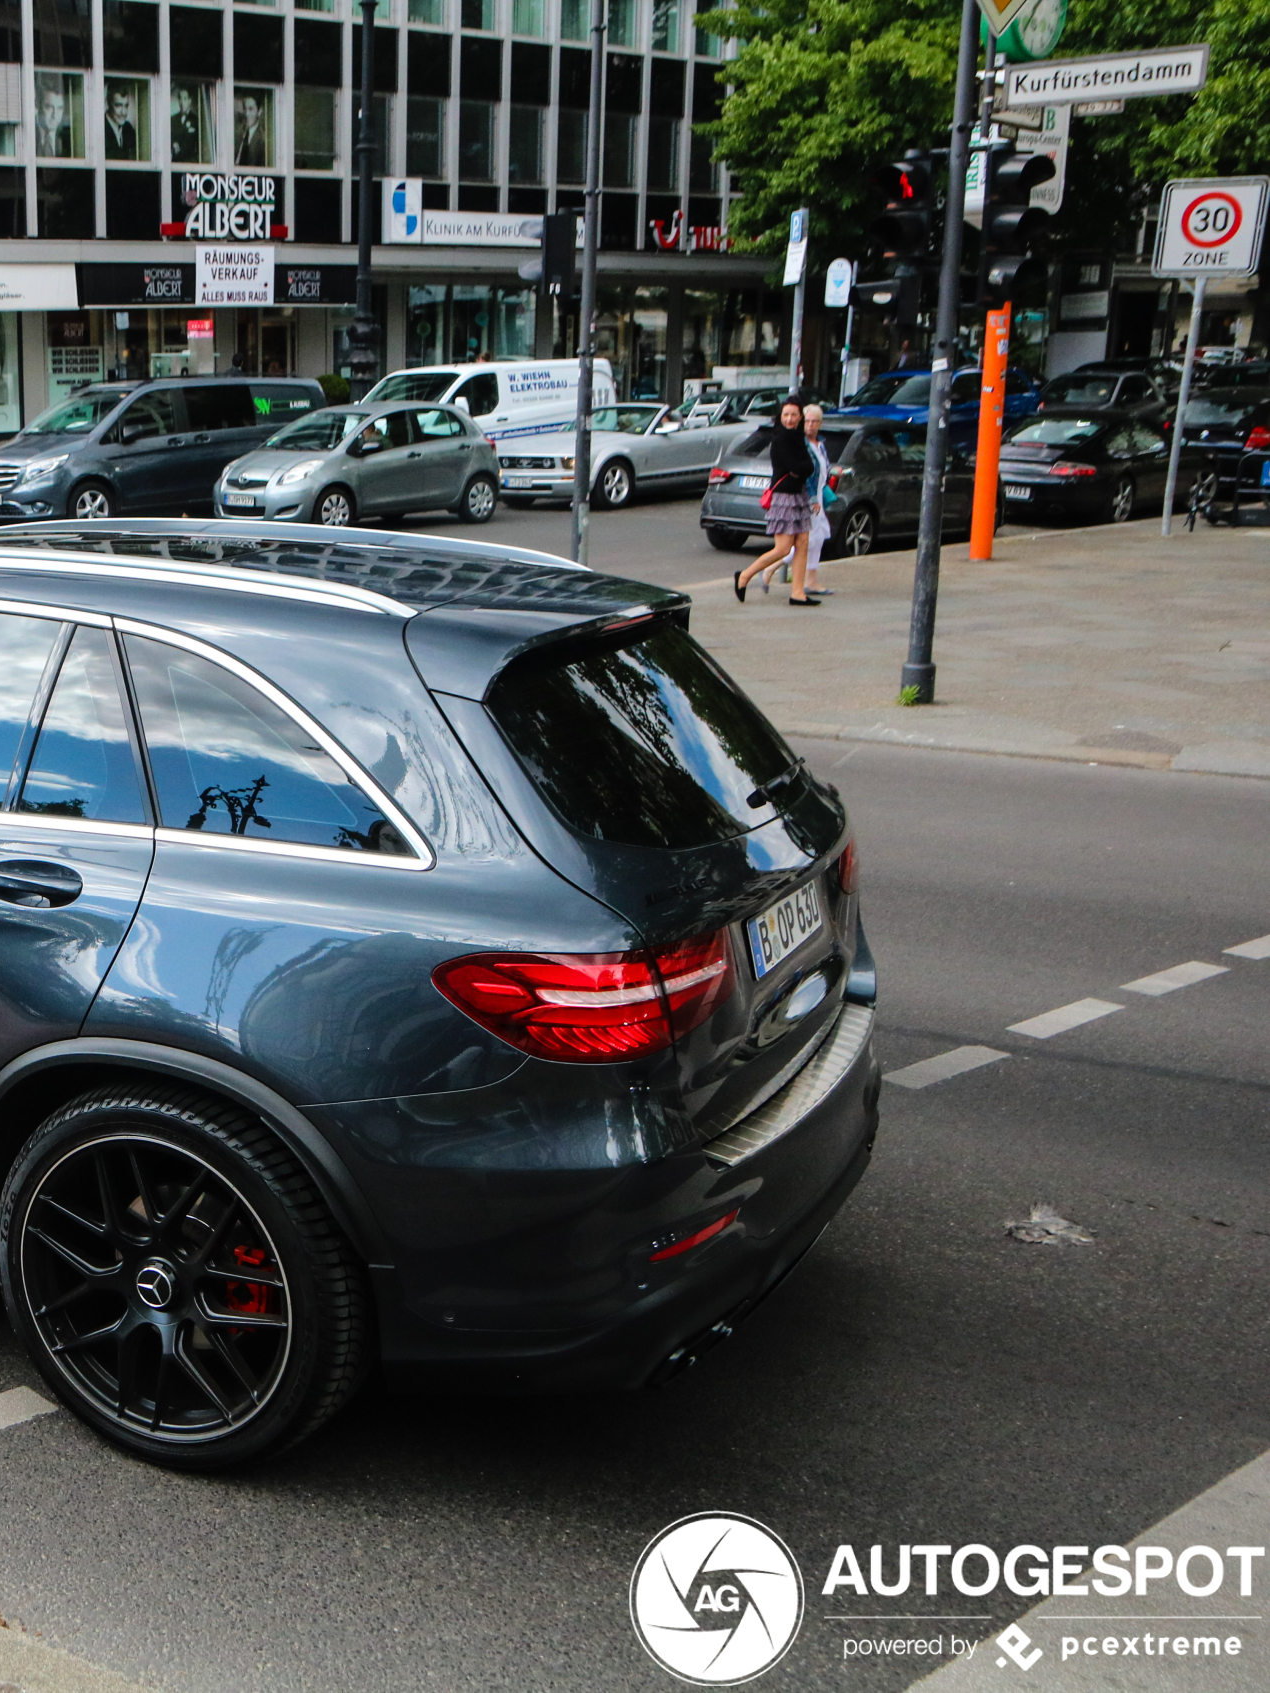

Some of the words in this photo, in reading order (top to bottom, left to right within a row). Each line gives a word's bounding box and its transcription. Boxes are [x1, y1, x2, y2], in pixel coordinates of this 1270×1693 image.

[1014, 61, 1192, 94] Kurfürstendamm
[185, 173, 275, 201] MONSIEUR
[185, 201, 275, 239] ALBERT
[1194, 206, 1229, 232] 30
[204, 249, 265, 266] RÄUMUNGS-
[1183, 251, 1230, 266] ZONE
[211, 267, 259, 281] VERKAUF
[146, 280, 182, 298] ALBERT
[201, 292, 225, 303] ALLES
[227, 291, 247, 302] MUSS
[249, 291, 268, 302] RAUS
[288, 281, 321, 298] ALBERT
[508, 373, 519, 382] W.
[521, 371, 551, 381] WIEHN
[510, 380, 568, 393] ELEKTROBAU
[758, 920, 773, 965] B
[777, 900, 795, 950] OP
[796, 882, 820, 934] 630
